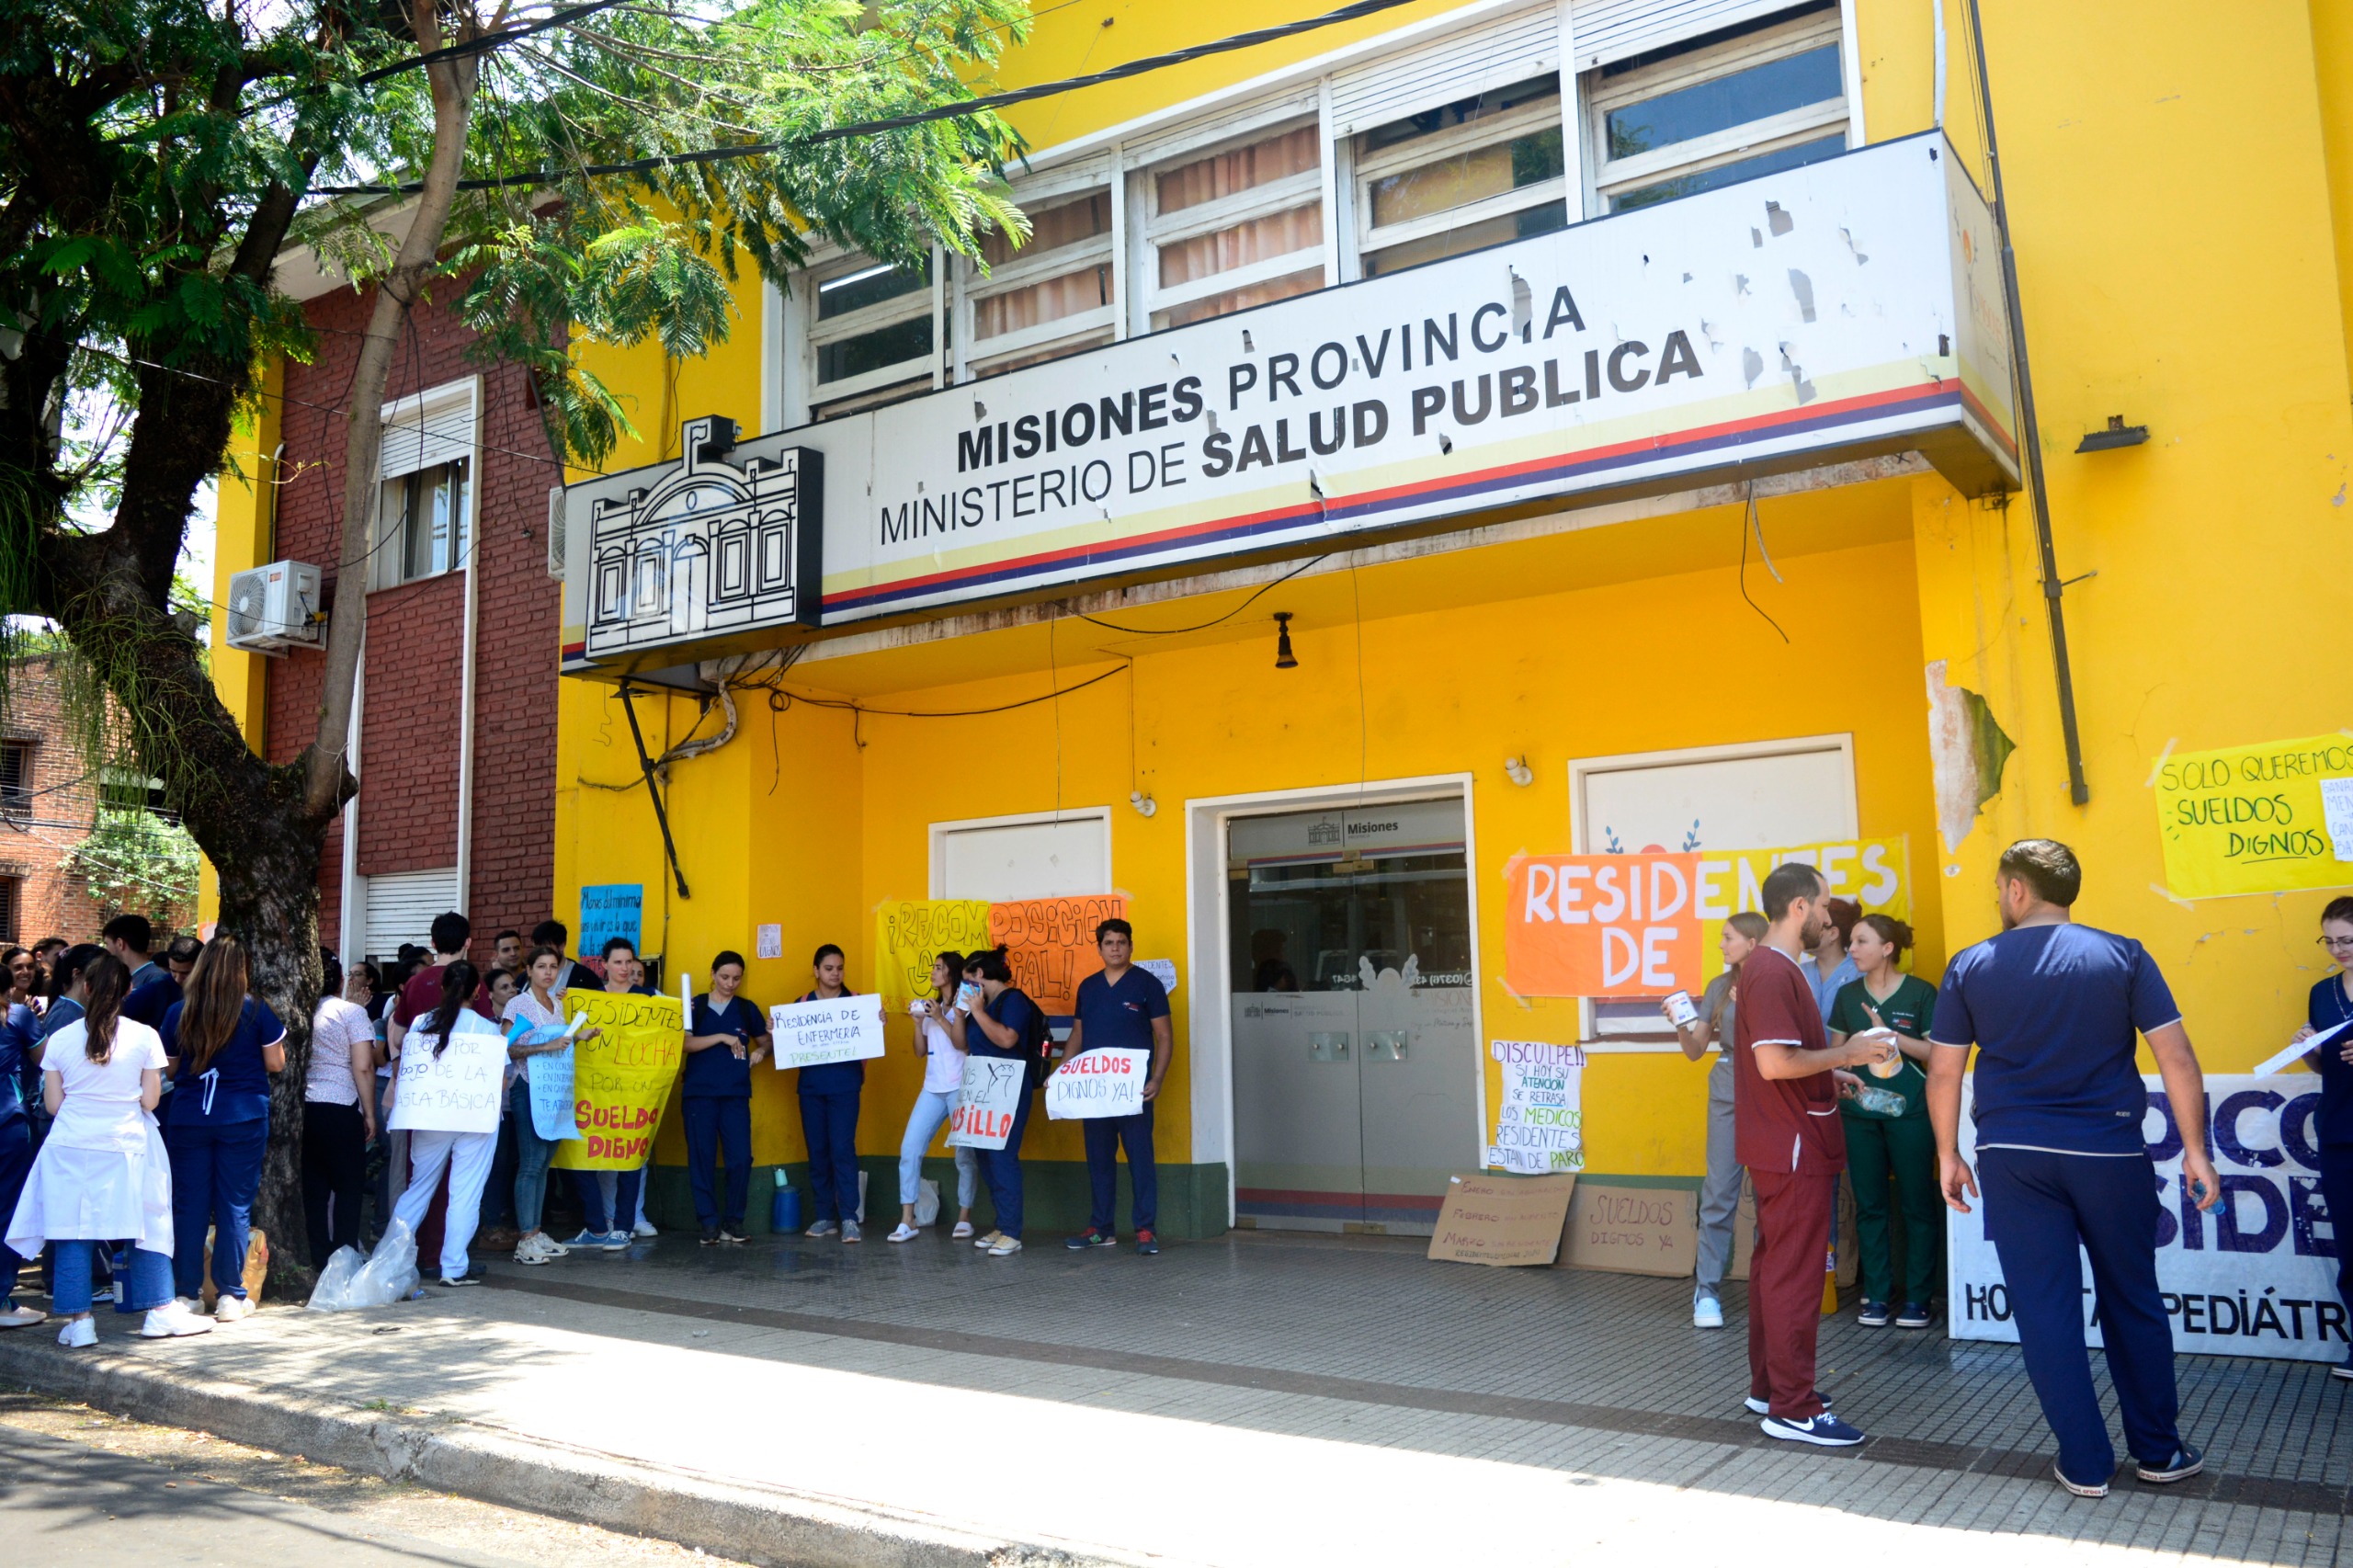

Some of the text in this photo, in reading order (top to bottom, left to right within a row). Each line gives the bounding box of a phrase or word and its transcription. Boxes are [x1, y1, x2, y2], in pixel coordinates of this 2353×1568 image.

[958, 376, 1203, 472] MISIONES
[881, 328, 1703, 545] MINISTERIO DE SALUD PUBLICA
[2162, 759, 2231, 791] SOLO
[2177, 794, 2292, 825] SUELDOS
[1347, 822, 1399, 835] Misiones
[2224, 829, 2325, 858] DIGNOS
[1602, 926, 1678, 988] DE
[841, 1009, 860, 1021] DE
[451, 1039, 482, 1055] POR
[614, 1036, 677, 1066] LUCHA
[1494, 1041, 1585, 1067] DISCULPE!!
[435, 1064, 454, 1078] DE
[464, 1065, 488, 1082] LA
[1060, 1055, 1131, 1074] SUELDOS
[1515, 1064, 1569, 1079] SI HOY SU
[591, 1073, 622, 1095] POR
[1057, 1078, 1134, 1103] DIGNOS YA!
[1512, 1088, 1566, 1106] SE RETRASA
[575, 1100, 659, 1130] SUELDO
[1501, 1107, 1582, 1130] LOS MEDICOS
[588, 1136, 649, 1160] DIGNO
[1496, 1125, 1582, 1151] RESIDENTES
[1528, 1152, 1544, 1169] DE
[1550, 1151, 1585, 1169] PARO
[1590, 1195, 1673, 1226] SUELDOS
[1658, 1234, 1674, 1252] YA
